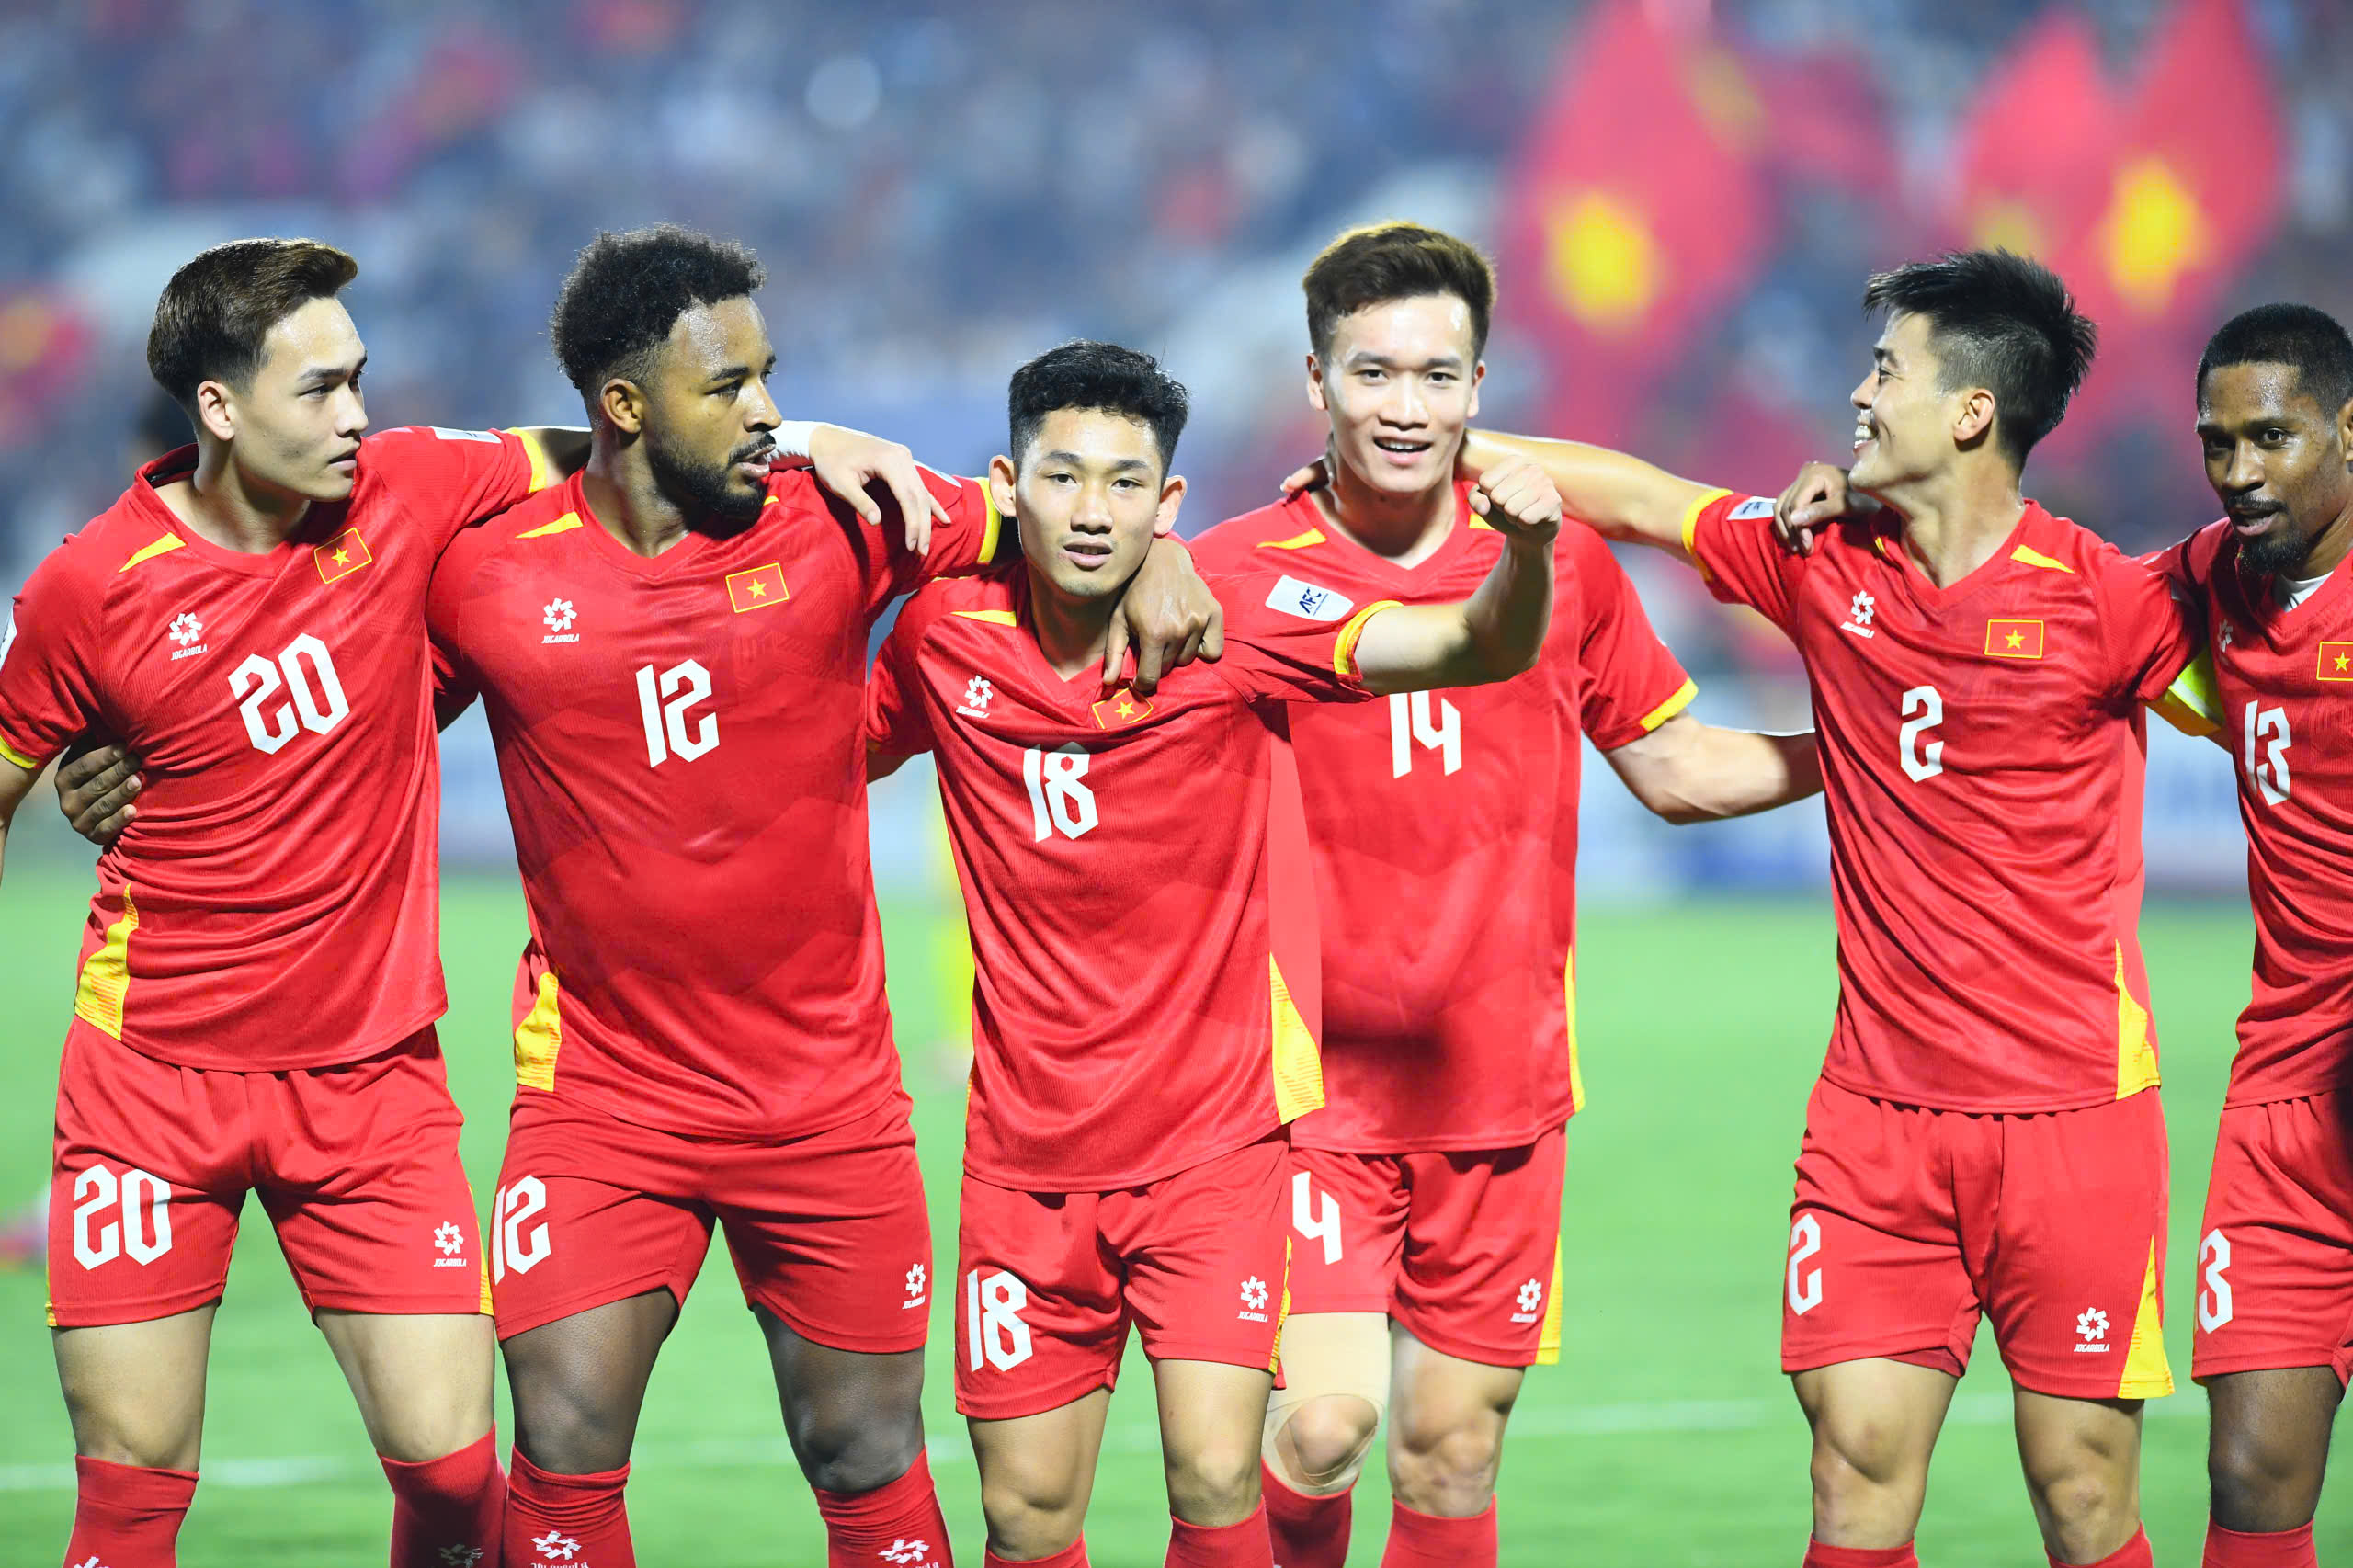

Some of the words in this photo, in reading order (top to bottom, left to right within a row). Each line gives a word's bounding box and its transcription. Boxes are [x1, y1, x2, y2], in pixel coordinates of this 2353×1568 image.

[171, 643, 208, 661] JOGARBOLA
[540, 632, 580, 644] JOGARBOLA
[1298, 587, 1322, 615] AFC
[228, 632, 350, 755] 20
[635, 658, 720, 768] 12
[1389, 691, 1461, 779] 14
[1900, 685, 1945, 783] 2
[1022, 741, 1099, 844] 18
[2245, 699, 2291, 806] 13
[73, 1164, 173, 1271] 20
[492, 1175, 552, 1286] 12
[1788, 1213, 1823, 1316] 2
[966, 1269, 1033, 1372] 18
